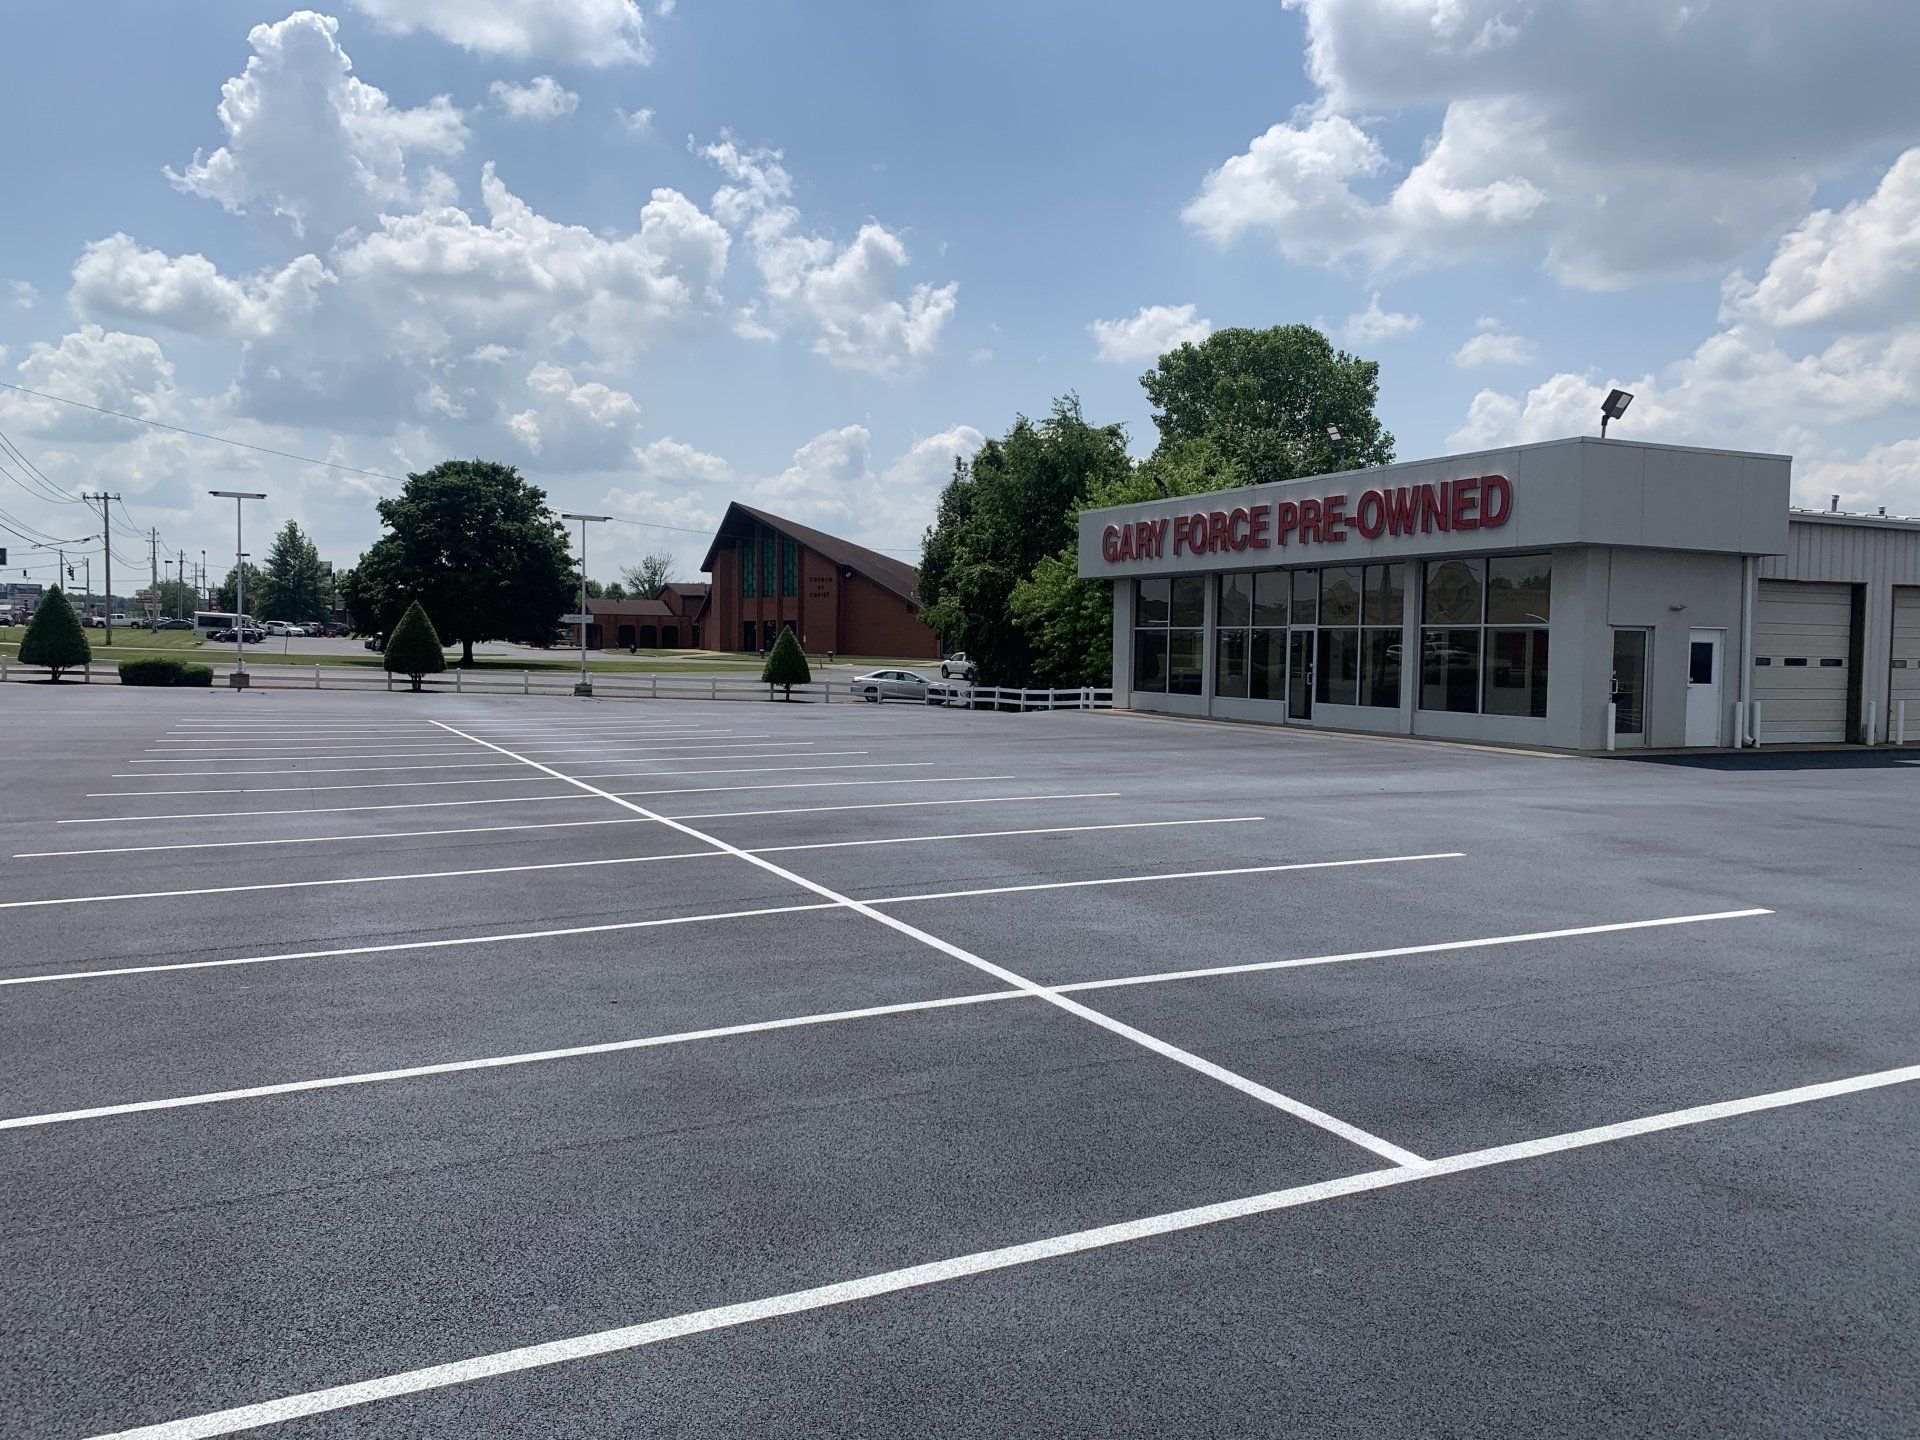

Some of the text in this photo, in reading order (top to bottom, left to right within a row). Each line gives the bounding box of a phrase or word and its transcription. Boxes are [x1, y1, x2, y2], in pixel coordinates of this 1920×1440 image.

[1102, 473, 1513, 563] GARY FORCE PRE-OWNED
